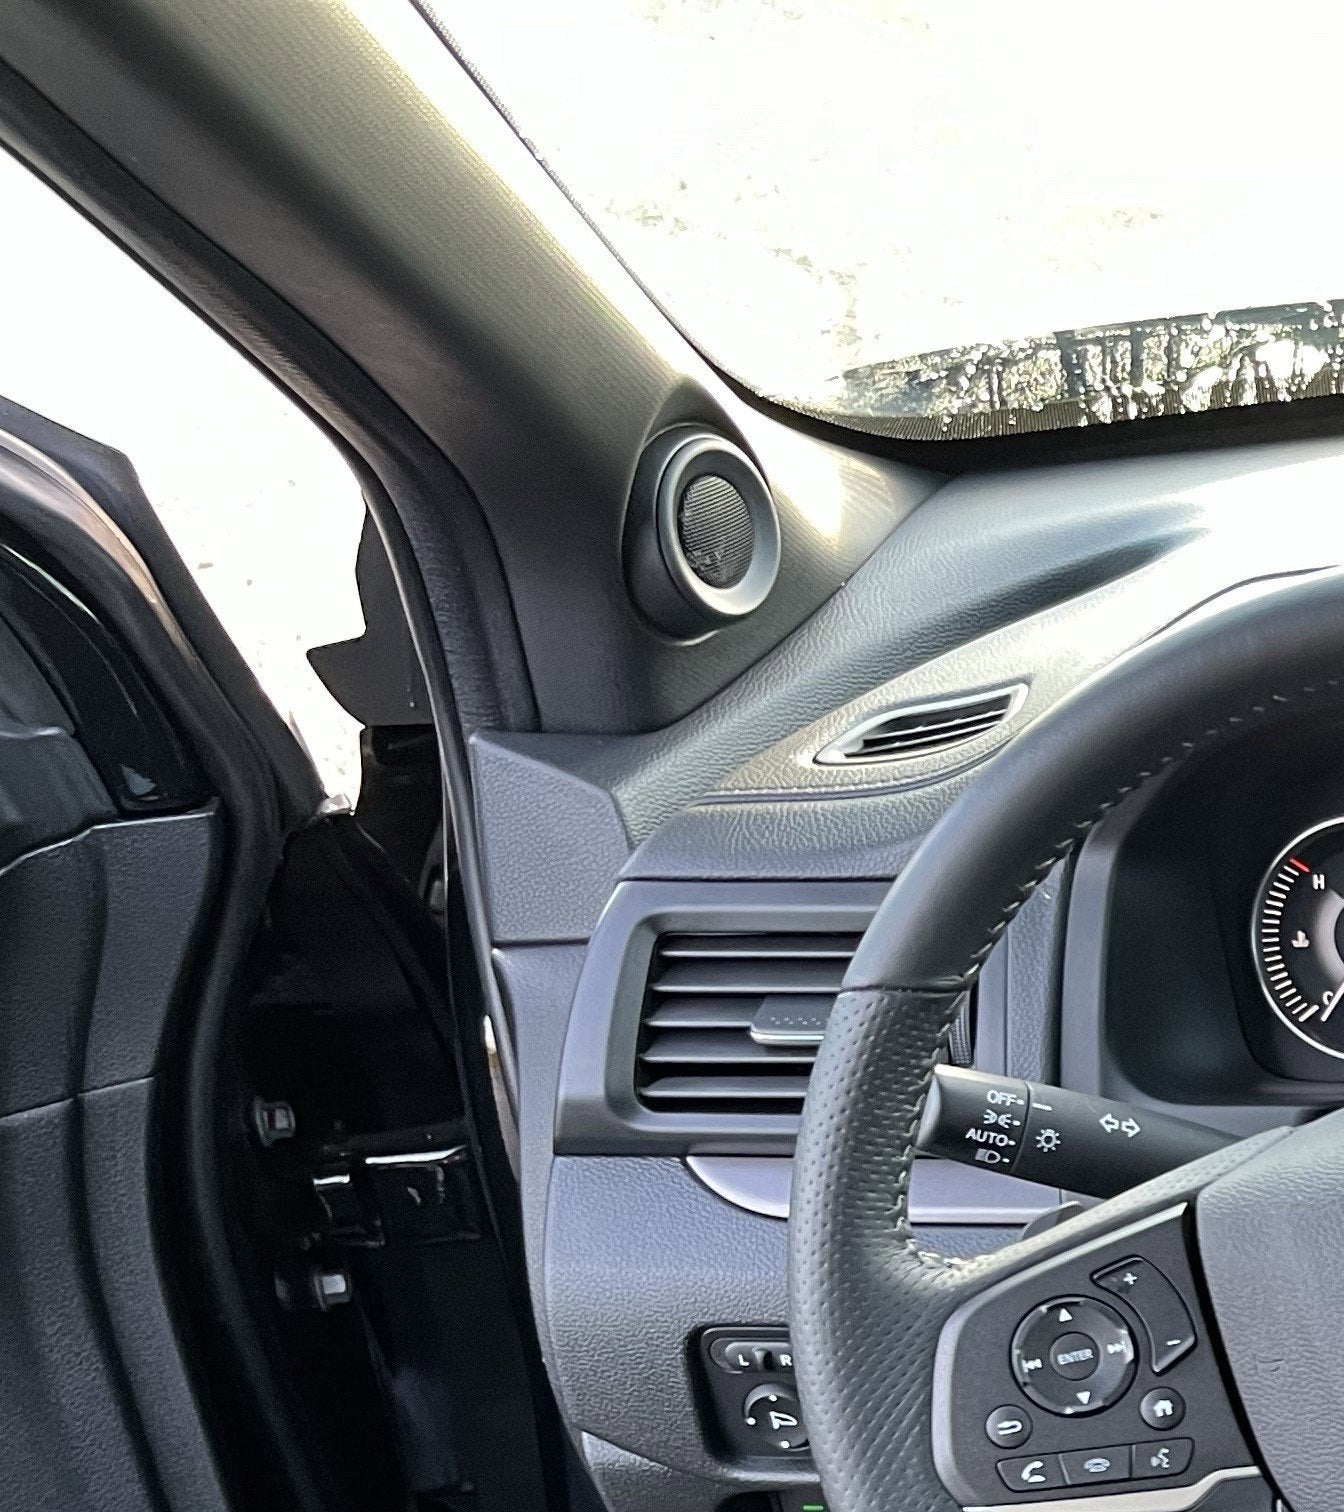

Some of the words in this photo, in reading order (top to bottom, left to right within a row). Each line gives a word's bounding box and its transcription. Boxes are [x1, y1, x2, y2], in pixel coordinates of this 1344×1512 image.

[1311, 873, 1327, 890] H
[985, 1089, 1018, 1108] OFF
[964, 1127, 1010, 1148] AUTO
[737, 1354, 751, 1367] L
[779, 1354, 793, 1367] R
